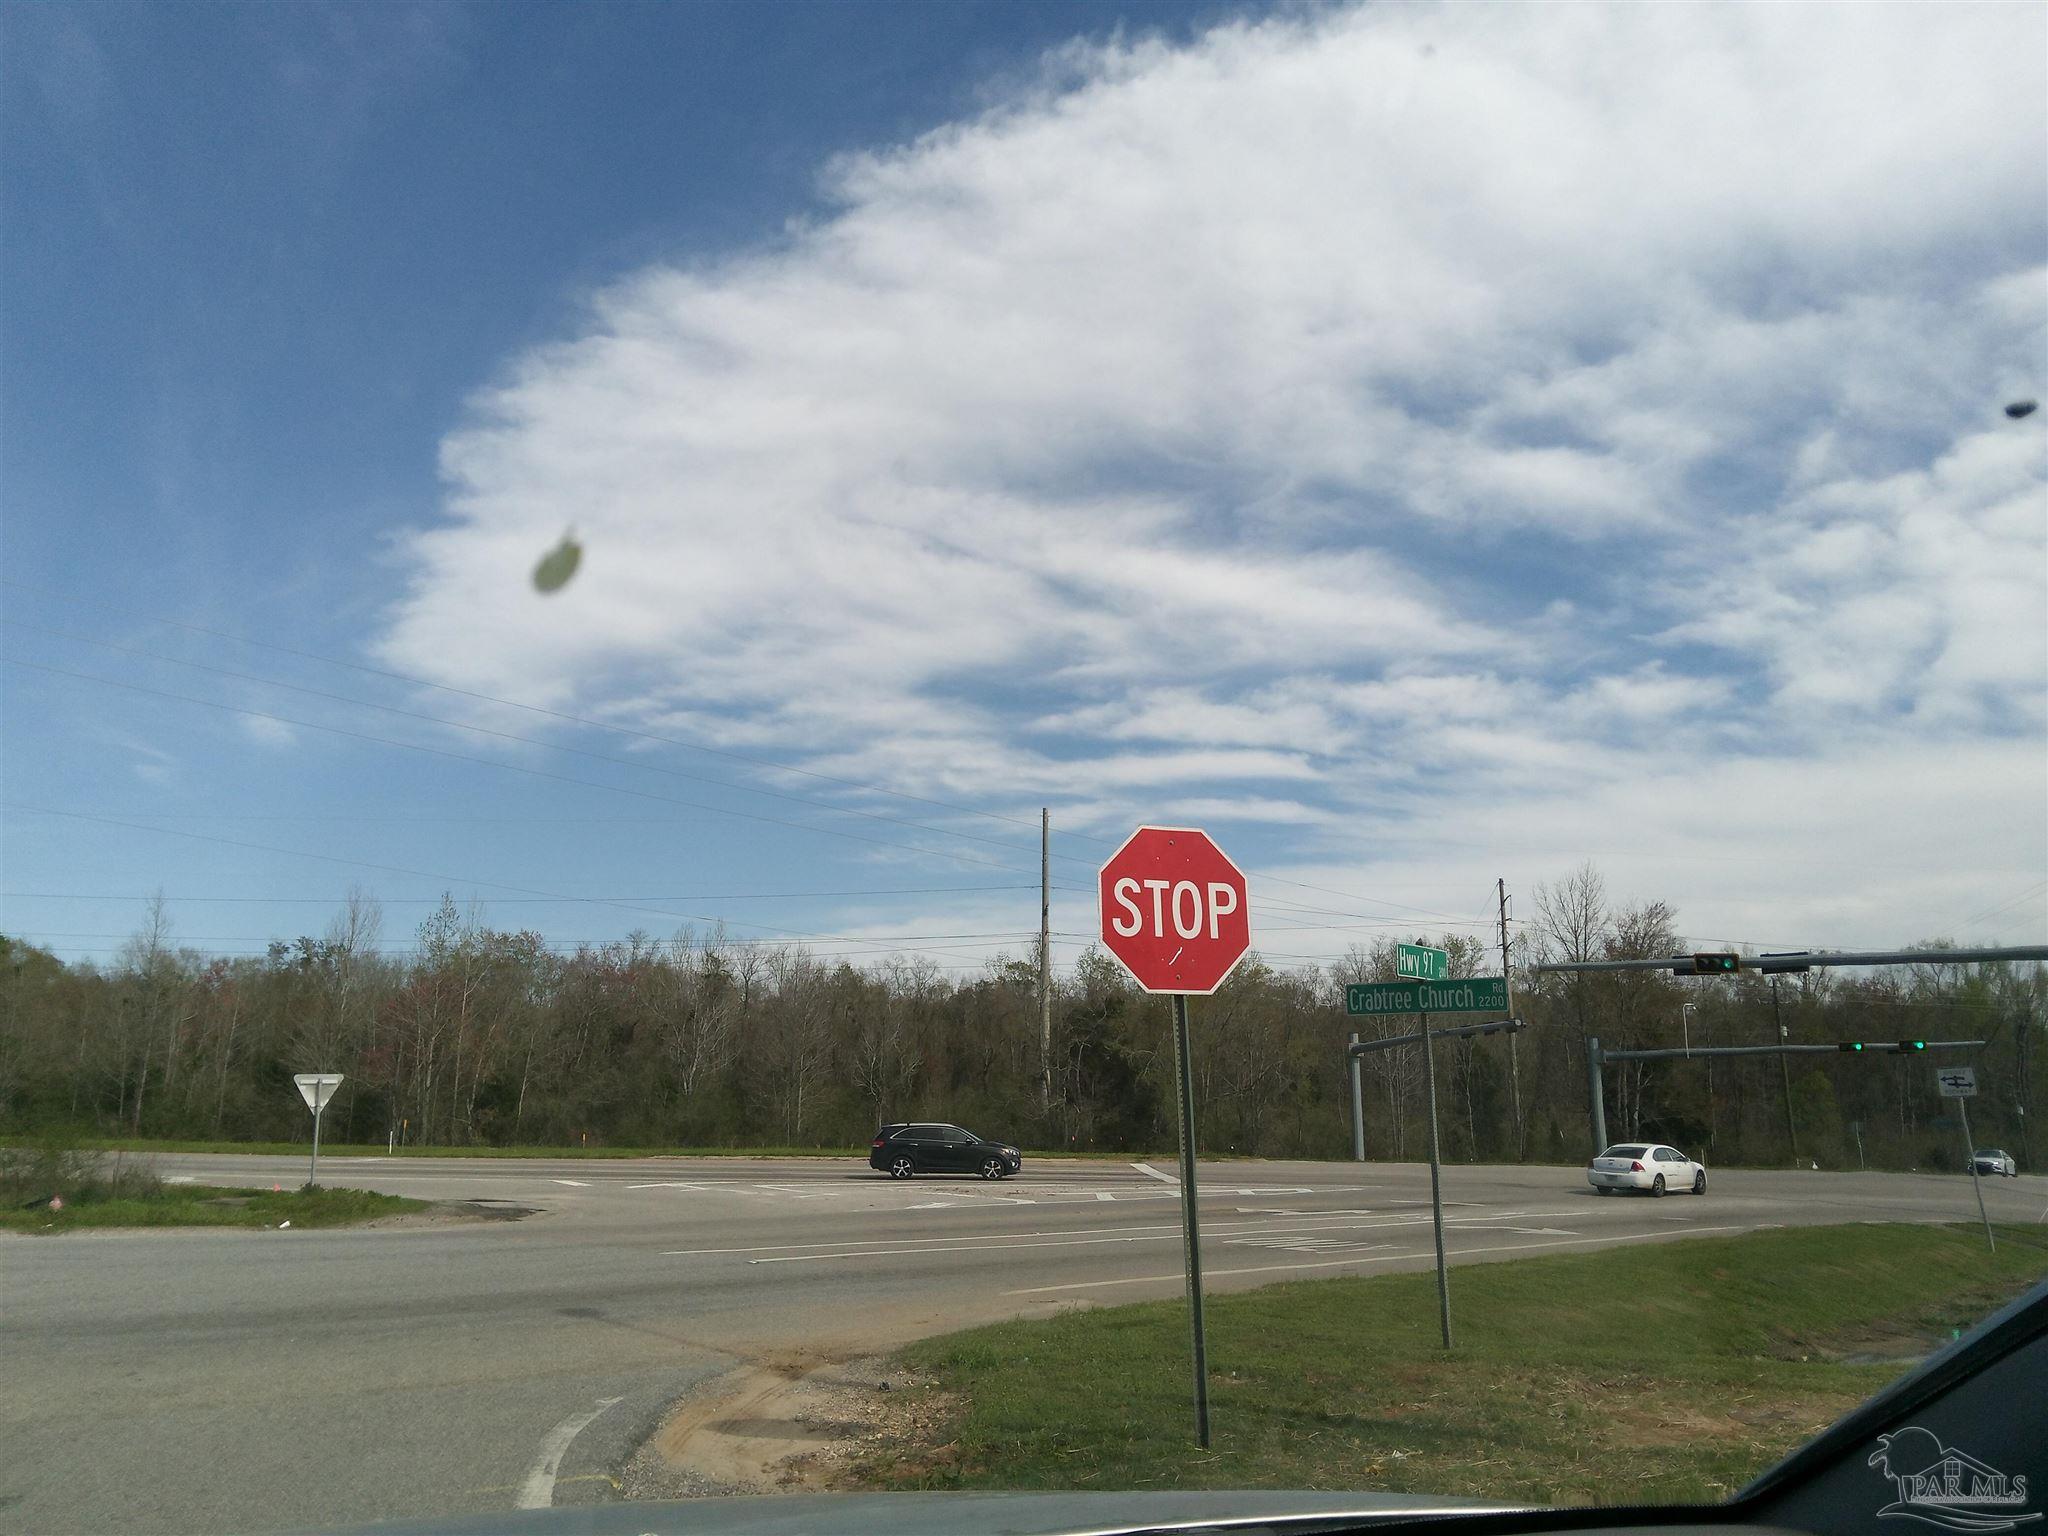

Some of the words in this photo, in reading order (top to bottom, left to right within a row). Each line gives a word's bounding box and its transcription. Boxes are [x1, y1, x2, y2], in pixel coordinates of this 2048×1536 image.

[1112, 877, 1237, 940] STOP
[1400, 948, 1420, 977] Hwy
[1423, 951, 1433, 975] 97
[1350, 987, 1412, 1011] Crabtree
[1418, 984, 1474, 1009] Church
[1478, 995, 1505, 1007] 2200
[1492, 982, 1504, 993] Rd
